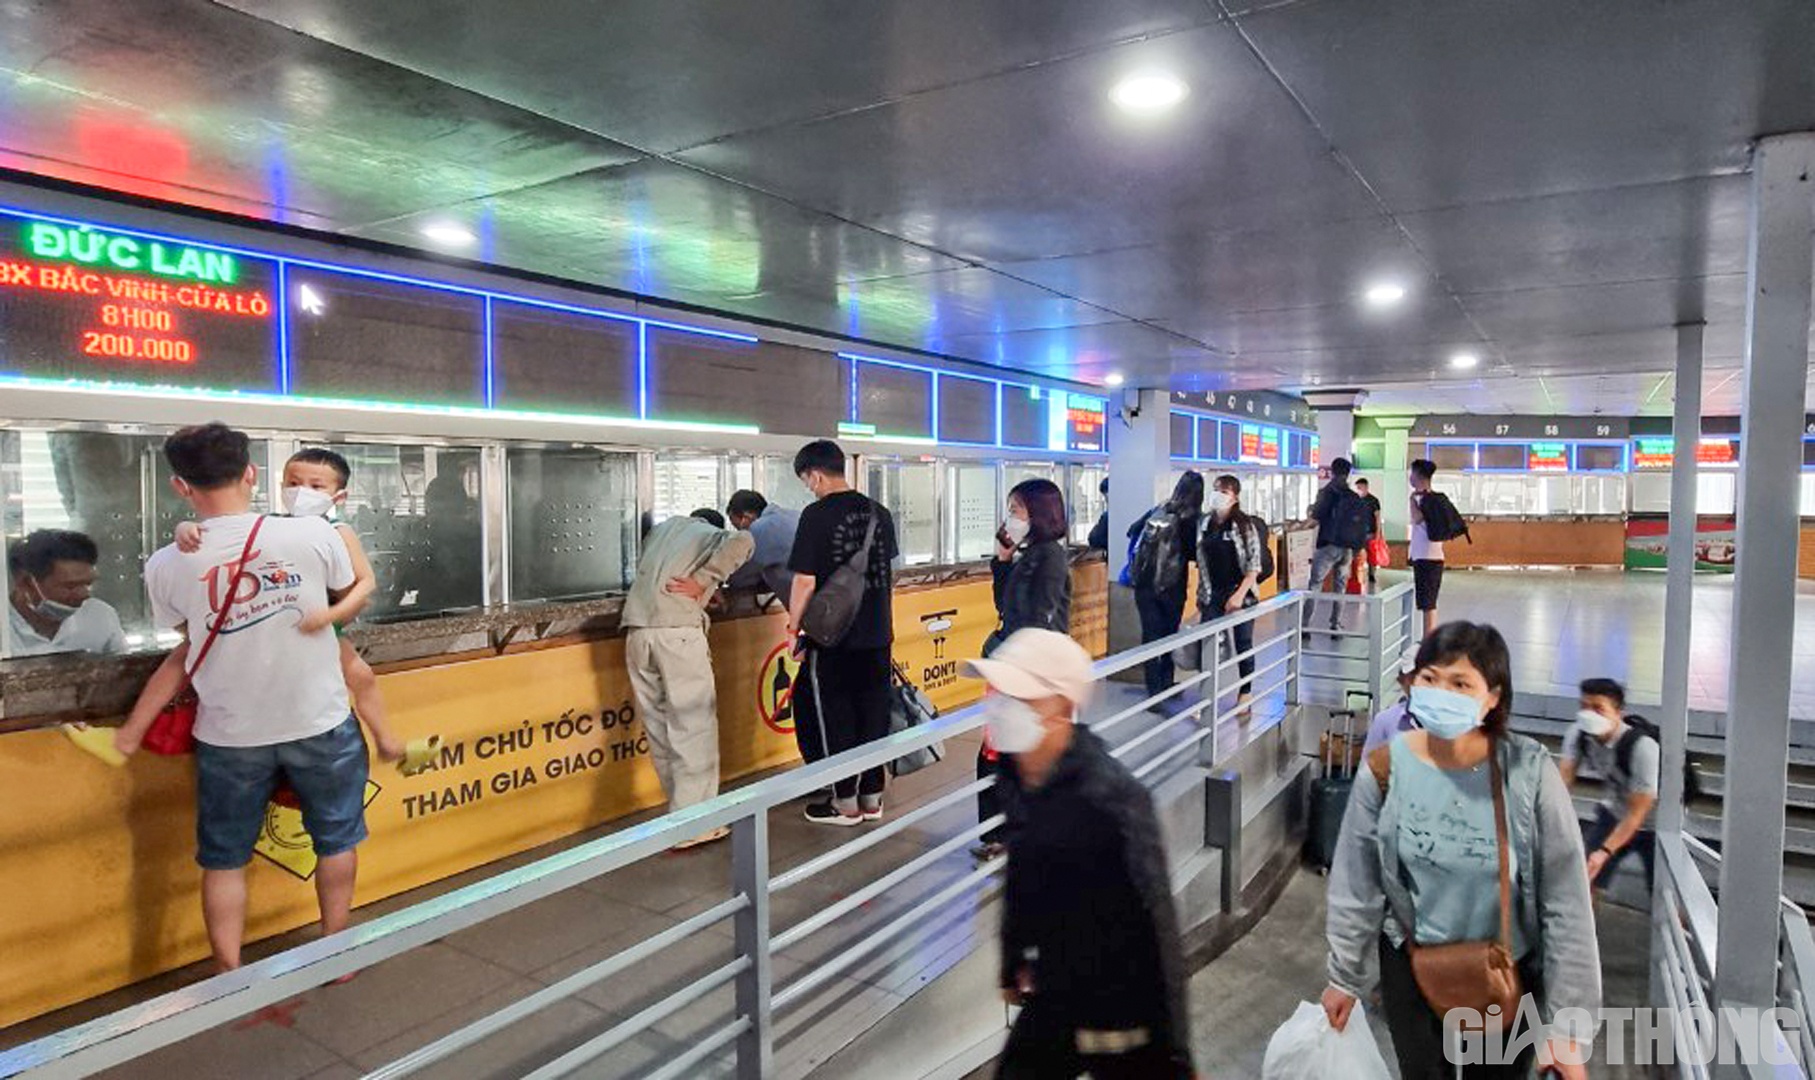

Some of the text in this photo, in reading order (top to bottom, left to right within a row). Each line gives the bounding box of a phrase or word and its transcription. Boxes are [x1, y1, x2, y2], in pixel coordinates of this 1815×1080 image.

[31, 223, 236, 283] ĐỨC LAN
[102, 304, 171, 332] 8H00
[83, 331, 191, 362] 200.000
[1442, 424, 1456, 434] 56
[1496, 425, 1510, 435] 57
[1597, 425, 1611, 436] 59
[924, 661, 956, 682] DON'T
[475, 720, 533, 759] CHỦ
[541, 708, 593, 743] TỐC
[601, 700, 635, 730] ĐỘ
[403, 779, 482, 819] THAM
[491, 766, 537, 794] GIA
[545, 748, 604, 778] GIAO
